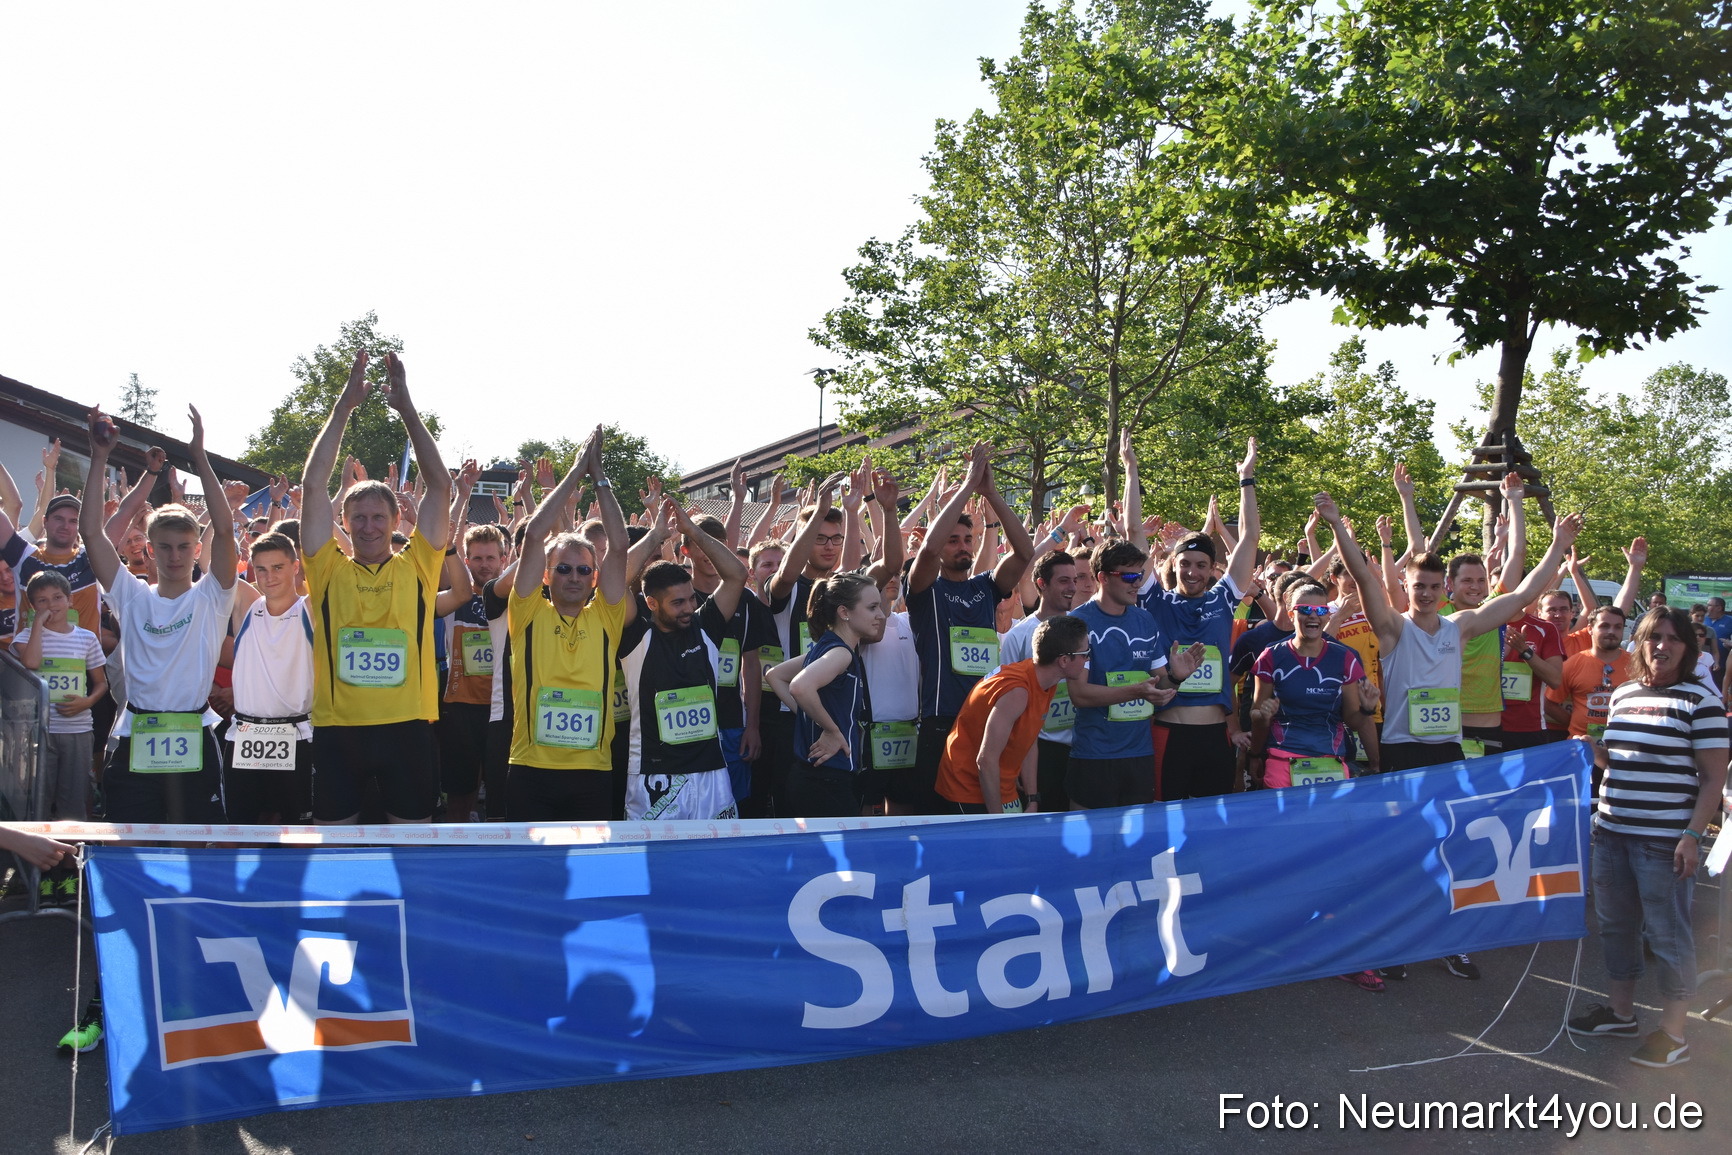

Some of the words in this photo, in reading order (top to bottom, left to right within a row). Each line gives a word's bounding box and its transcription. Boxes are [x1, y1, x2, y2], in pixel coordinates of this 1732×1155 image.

[1336, 627, 1360, 640] MAX
[345, 652, 400, 672] 1359
[473, 648, 493, 662] 46
[960, 646, 990, 663] 384
[543, 711, 593, 733] 1361
[664, 708, 710, 730] 1089
[1420, 707, 1450, 722] 353
[240, 724, 288, 734] df-sports
[146, 737, 188, 756] 113
[241, 740, 289, 759] 8923
[882, 740, 911, 756] 977
[788, 846, 1208, 1029] Start
